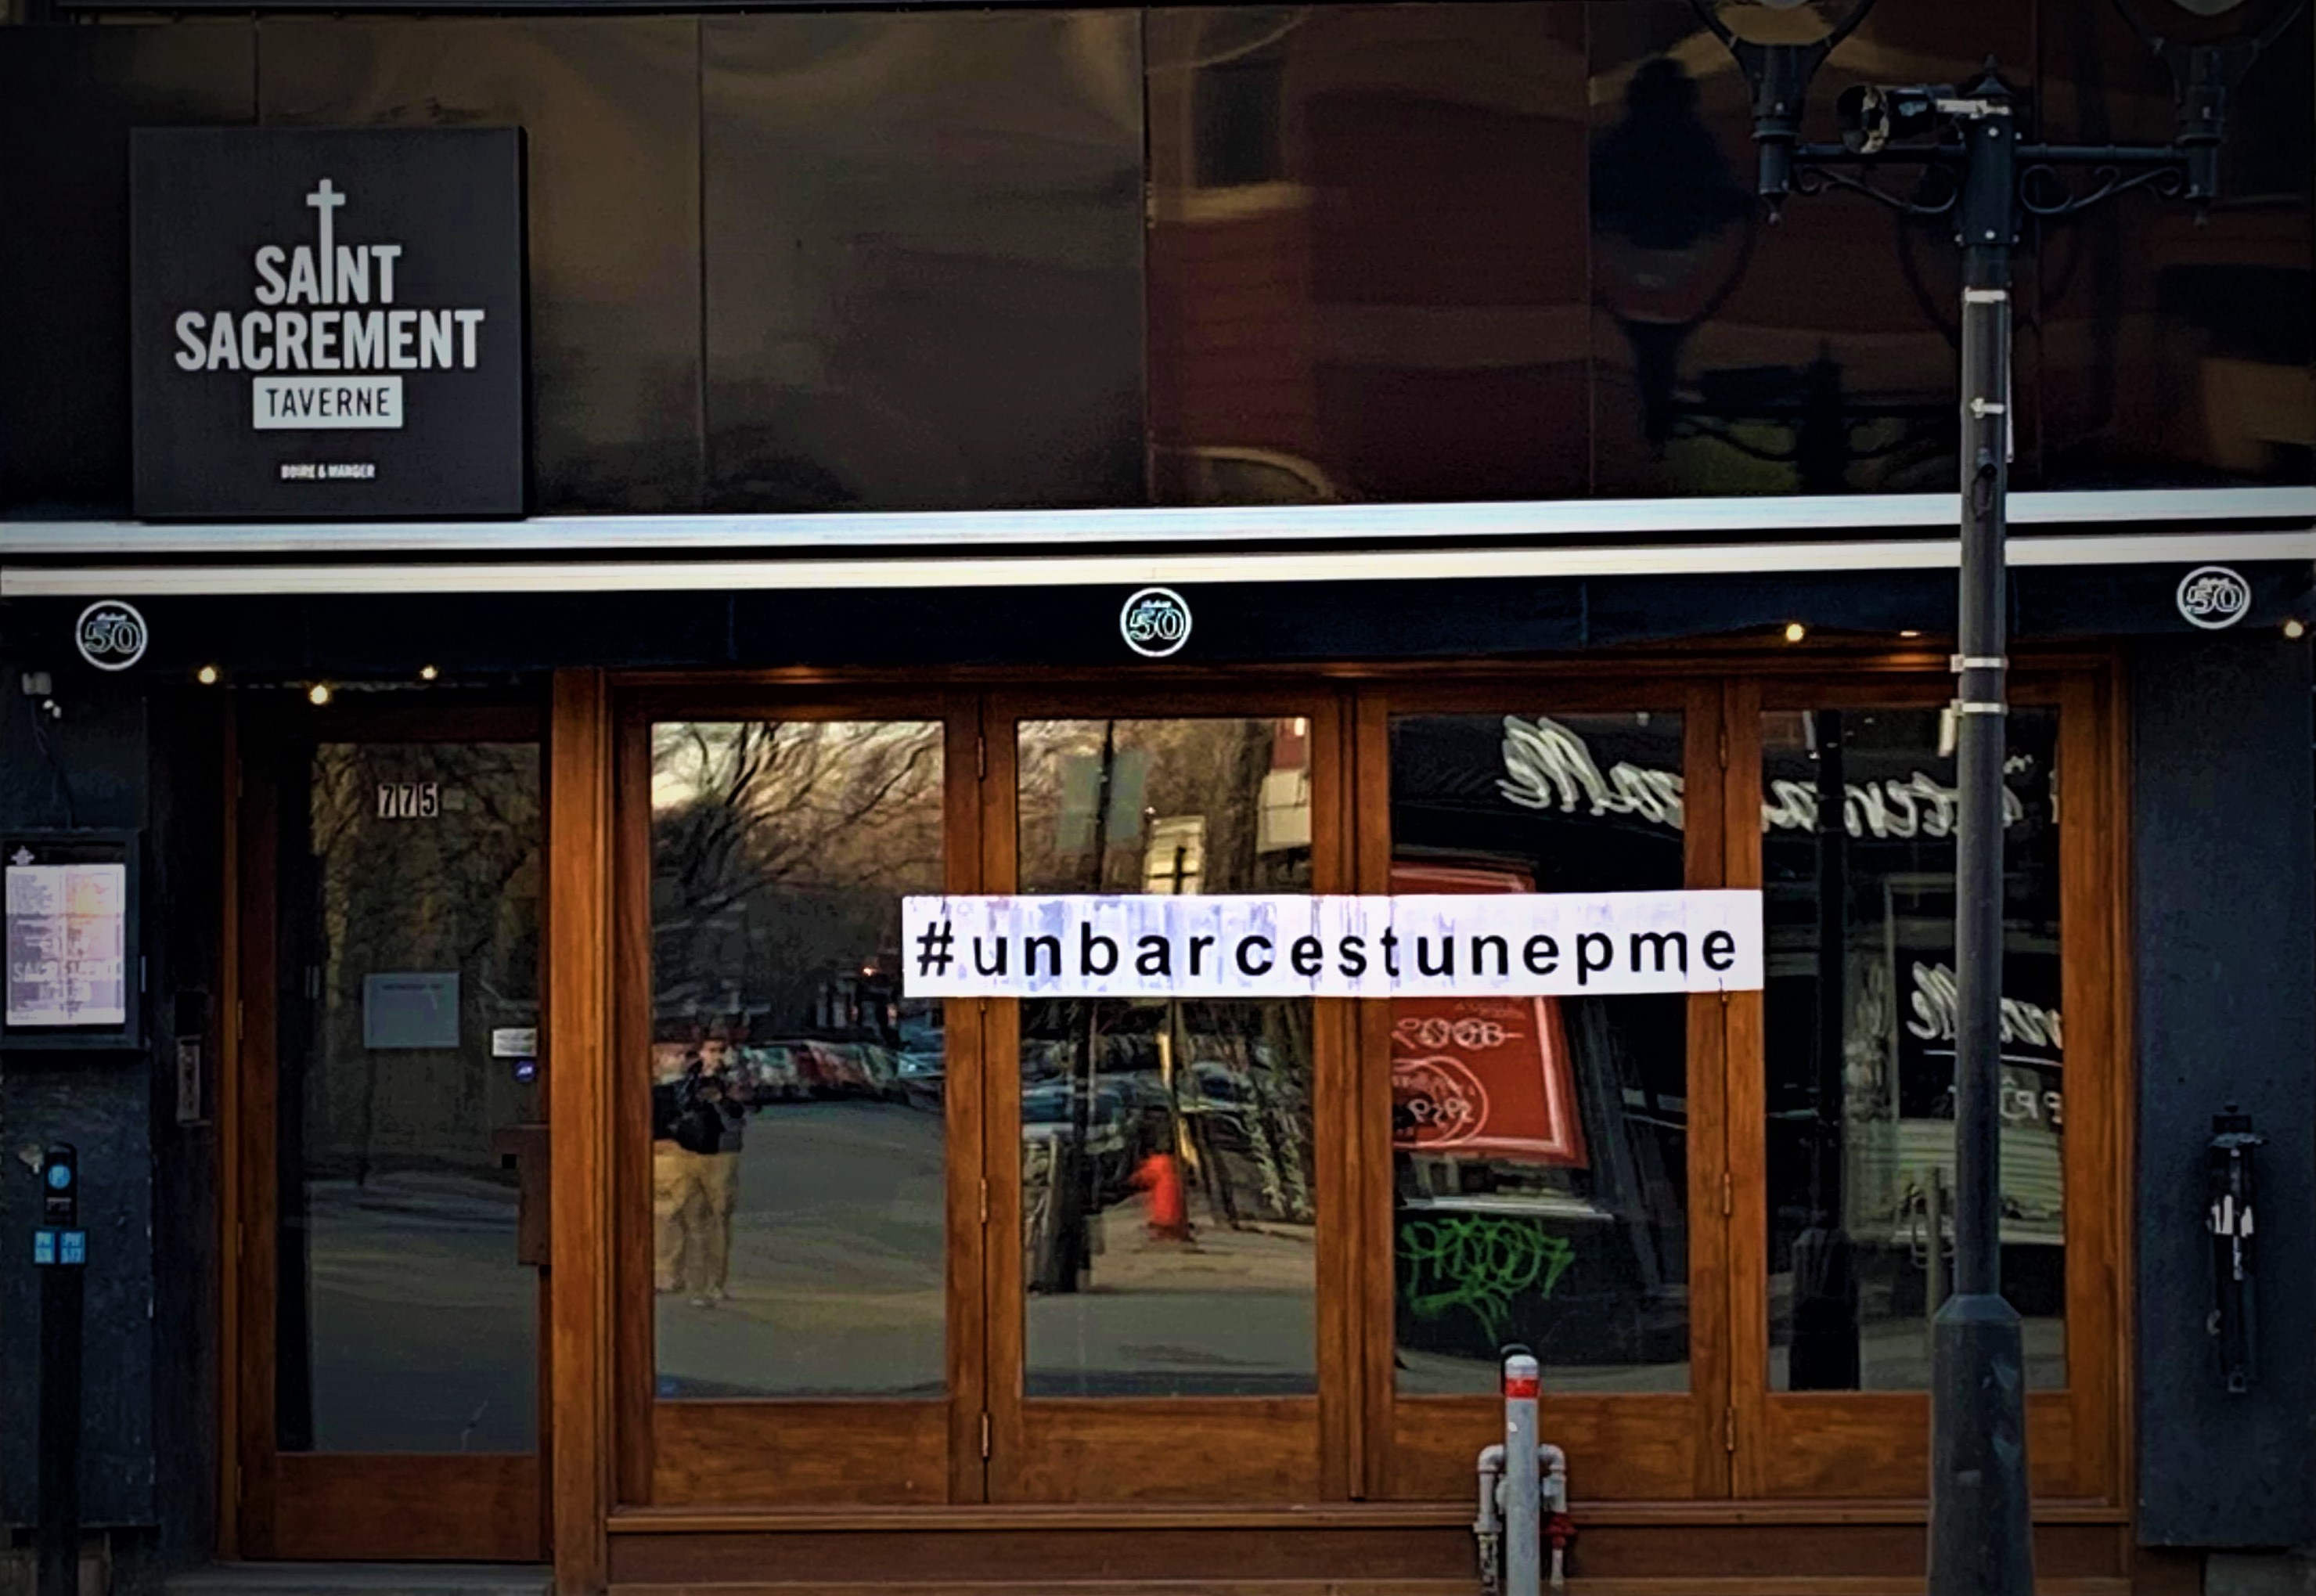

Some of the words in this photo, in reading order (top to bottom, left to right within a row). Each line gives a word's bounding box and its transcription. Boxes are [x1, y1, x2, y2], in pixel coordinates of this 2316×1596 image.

[255, 244, 401, 304] SAINT
[175, 310, 484, 370] SACREMENT
[265, 387, 391, 418] TAVERNE
[2186, 585, 2244, 615] 50
[84, 621, 142, 655] 50
[1129, 607, 1184, 642] 50
[381, 784, 436, 816] 775
[916, 920, 1736, 986] #unbarcestunepme
